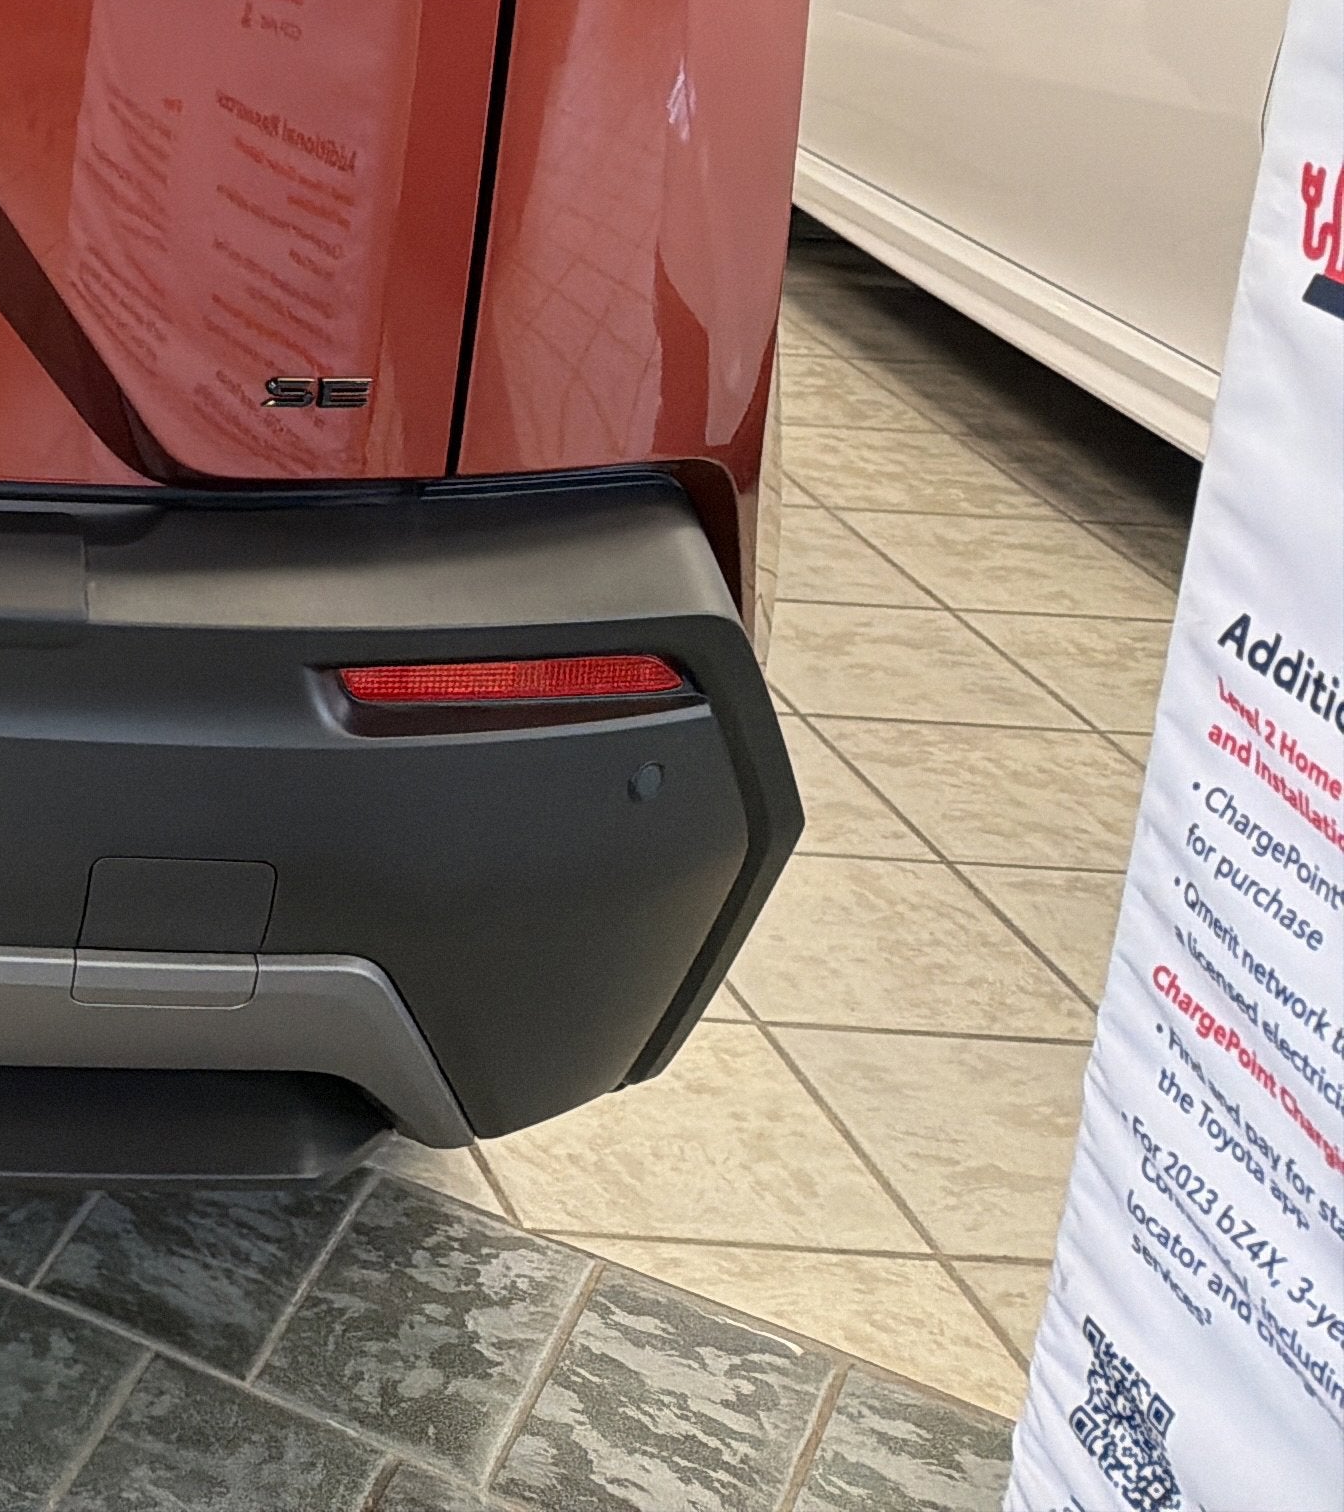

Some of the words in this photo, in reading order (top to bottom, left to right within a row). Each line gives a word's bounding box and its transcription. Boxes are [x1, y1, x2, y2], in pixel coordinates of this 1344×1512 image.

[261, 376, 374, 409] SE
[1208, 723, 1253, 768] and
[1264, 718, 1276, 750] 2
[1279, 730, 1343, 802] Home
[1185, 822, 1217, 863] for
[1213, 854, 1324, 952] purchase
[1183, 881, 1240, 960] Qmerit
[1241, 948, 1332, 1042] network
[1152, 964, 1278, 1100] ChargePoint
[1187, 930, 1260, 1028] licensed
[1262, 1019, 1344, 1118] electrici
[1157, 1066, 1195, 1115] the
[1198, 1099, 1265, 1185] Toyota
[1284, 1157, 1316, 1204] for
[1127, 1188, 1208, 1277] locator
[1132, 1114, 1162, 1161] For
[1163, 1150, 1219, 1216] 2023
[1215, 1203, 1289, 1289] bZ4X,
[1286, 1275, 1344, 1351] 3-ye
